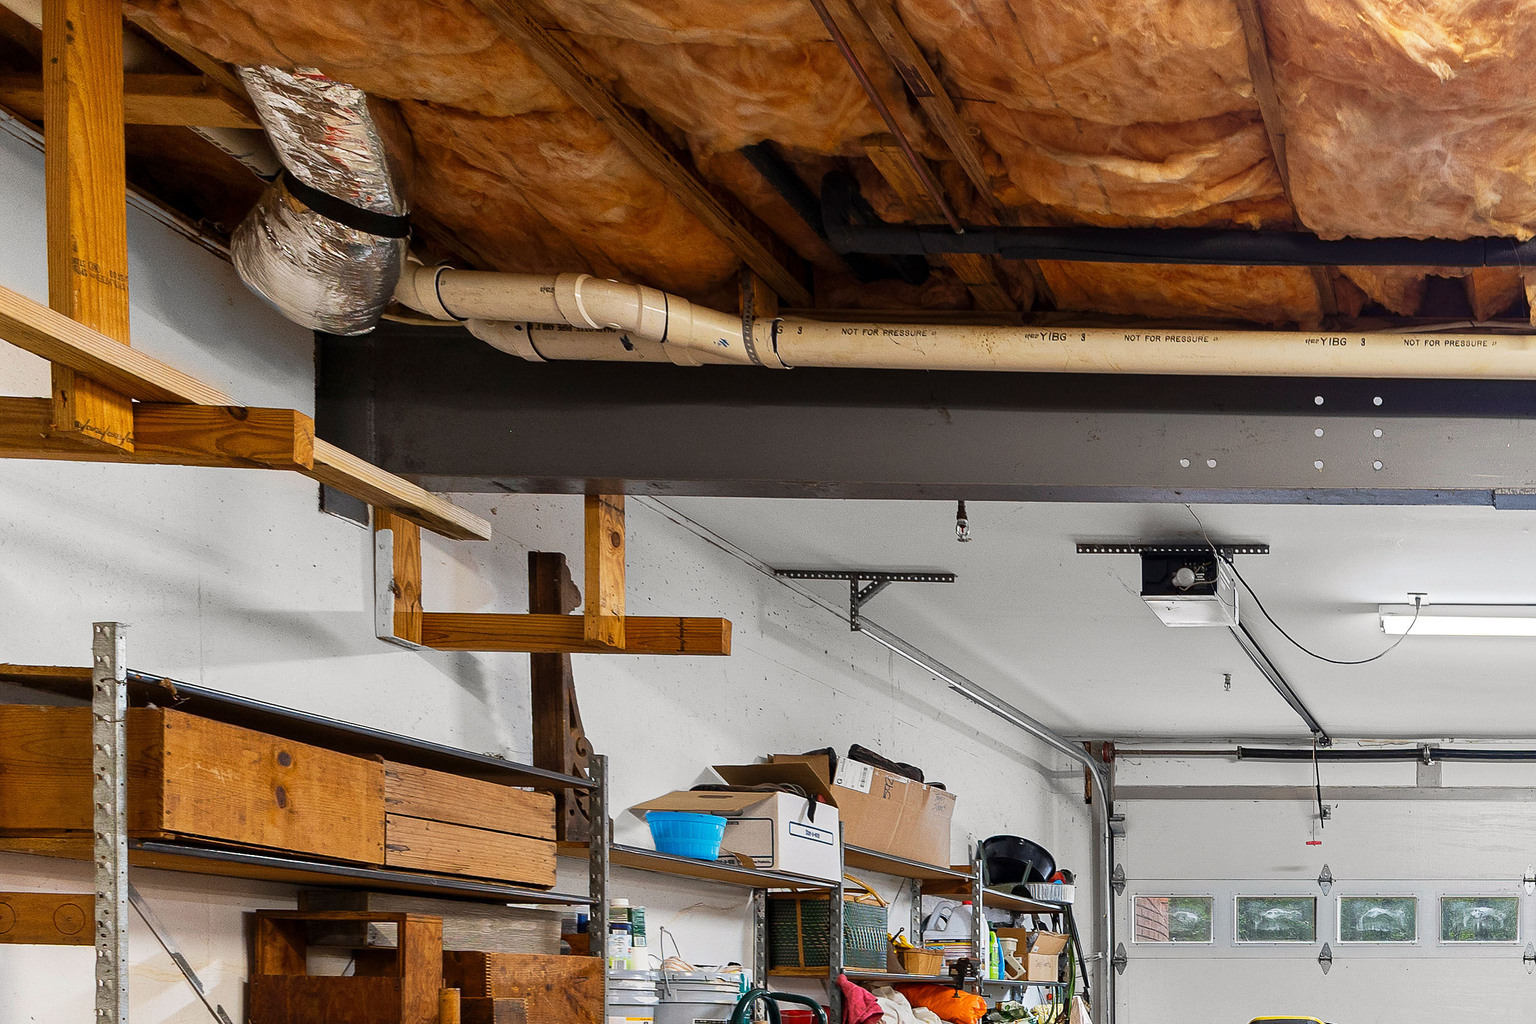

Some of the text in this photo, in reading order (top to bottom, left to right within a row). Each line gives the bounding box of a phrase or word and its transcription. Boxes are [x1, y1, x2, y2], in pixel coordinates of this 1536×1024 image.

[841, 328, 858, 336] NOT
[862, 328, 879, 336] FOR
[882, 329, 928, 337] PRESSURE
[1124, 334, 1141, 342] NOT
[1164, 335, 1209, 343] PRESSURE
[1403, 339, 1420, 347] NOT
[1424, 339, 1441, 347] FOR
[1444, 339, 1488, 348] PRESSURE
